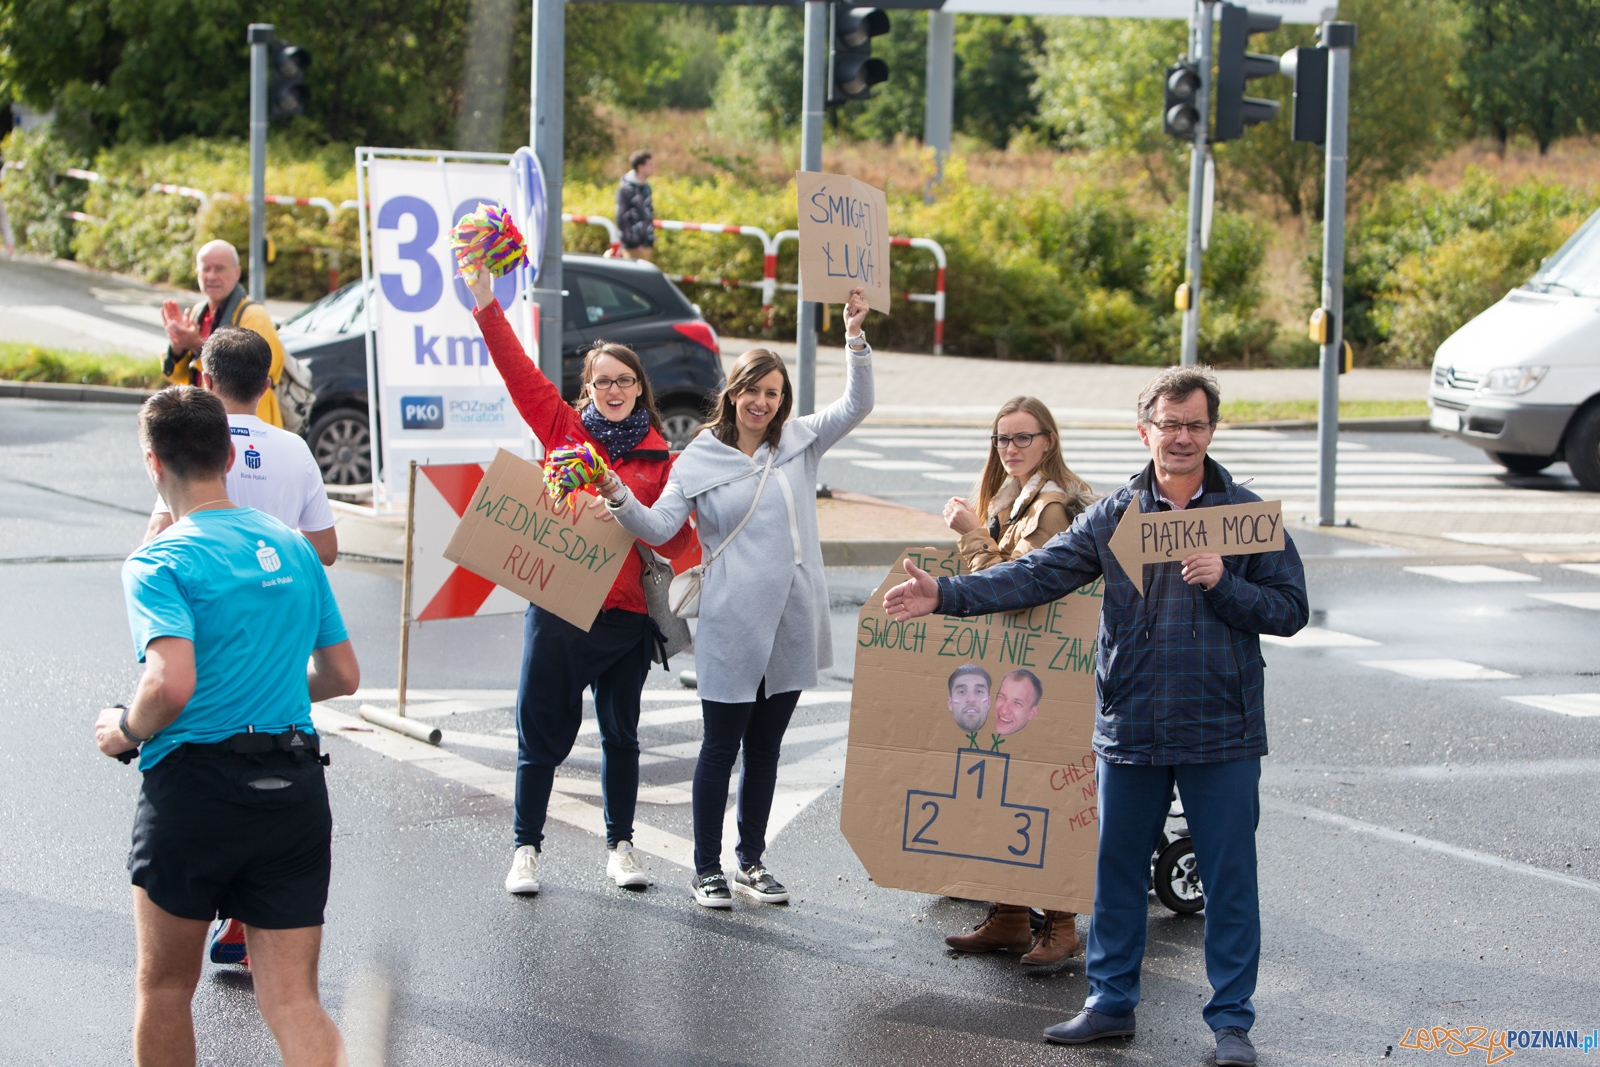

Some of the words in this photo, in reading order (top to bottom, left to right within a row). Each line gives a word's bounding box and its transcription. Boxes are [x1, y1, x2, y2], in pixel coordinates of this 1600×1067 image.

[810, 186, 873, 247] ŚMIGAJ
[413, 325, 489, 366] km
[405, 404, 439, 421] PKO
[449, 412, 504, 423] maraton
[475, 486, 617, 573] WEDNESDAY
[1141, 519, 1208, 557] PIĄTKA
[1222, 513, 1280, 545] MOCY
[502, 544, 556, 592] RUN
[858, 617, 927, 653] SWOICH
[999, 631, 1042, 667] NIE
[967, 759, 986, 800] 1
[911, 801, 939, 846] 2
[1007, 812, 1032, 857] 3
